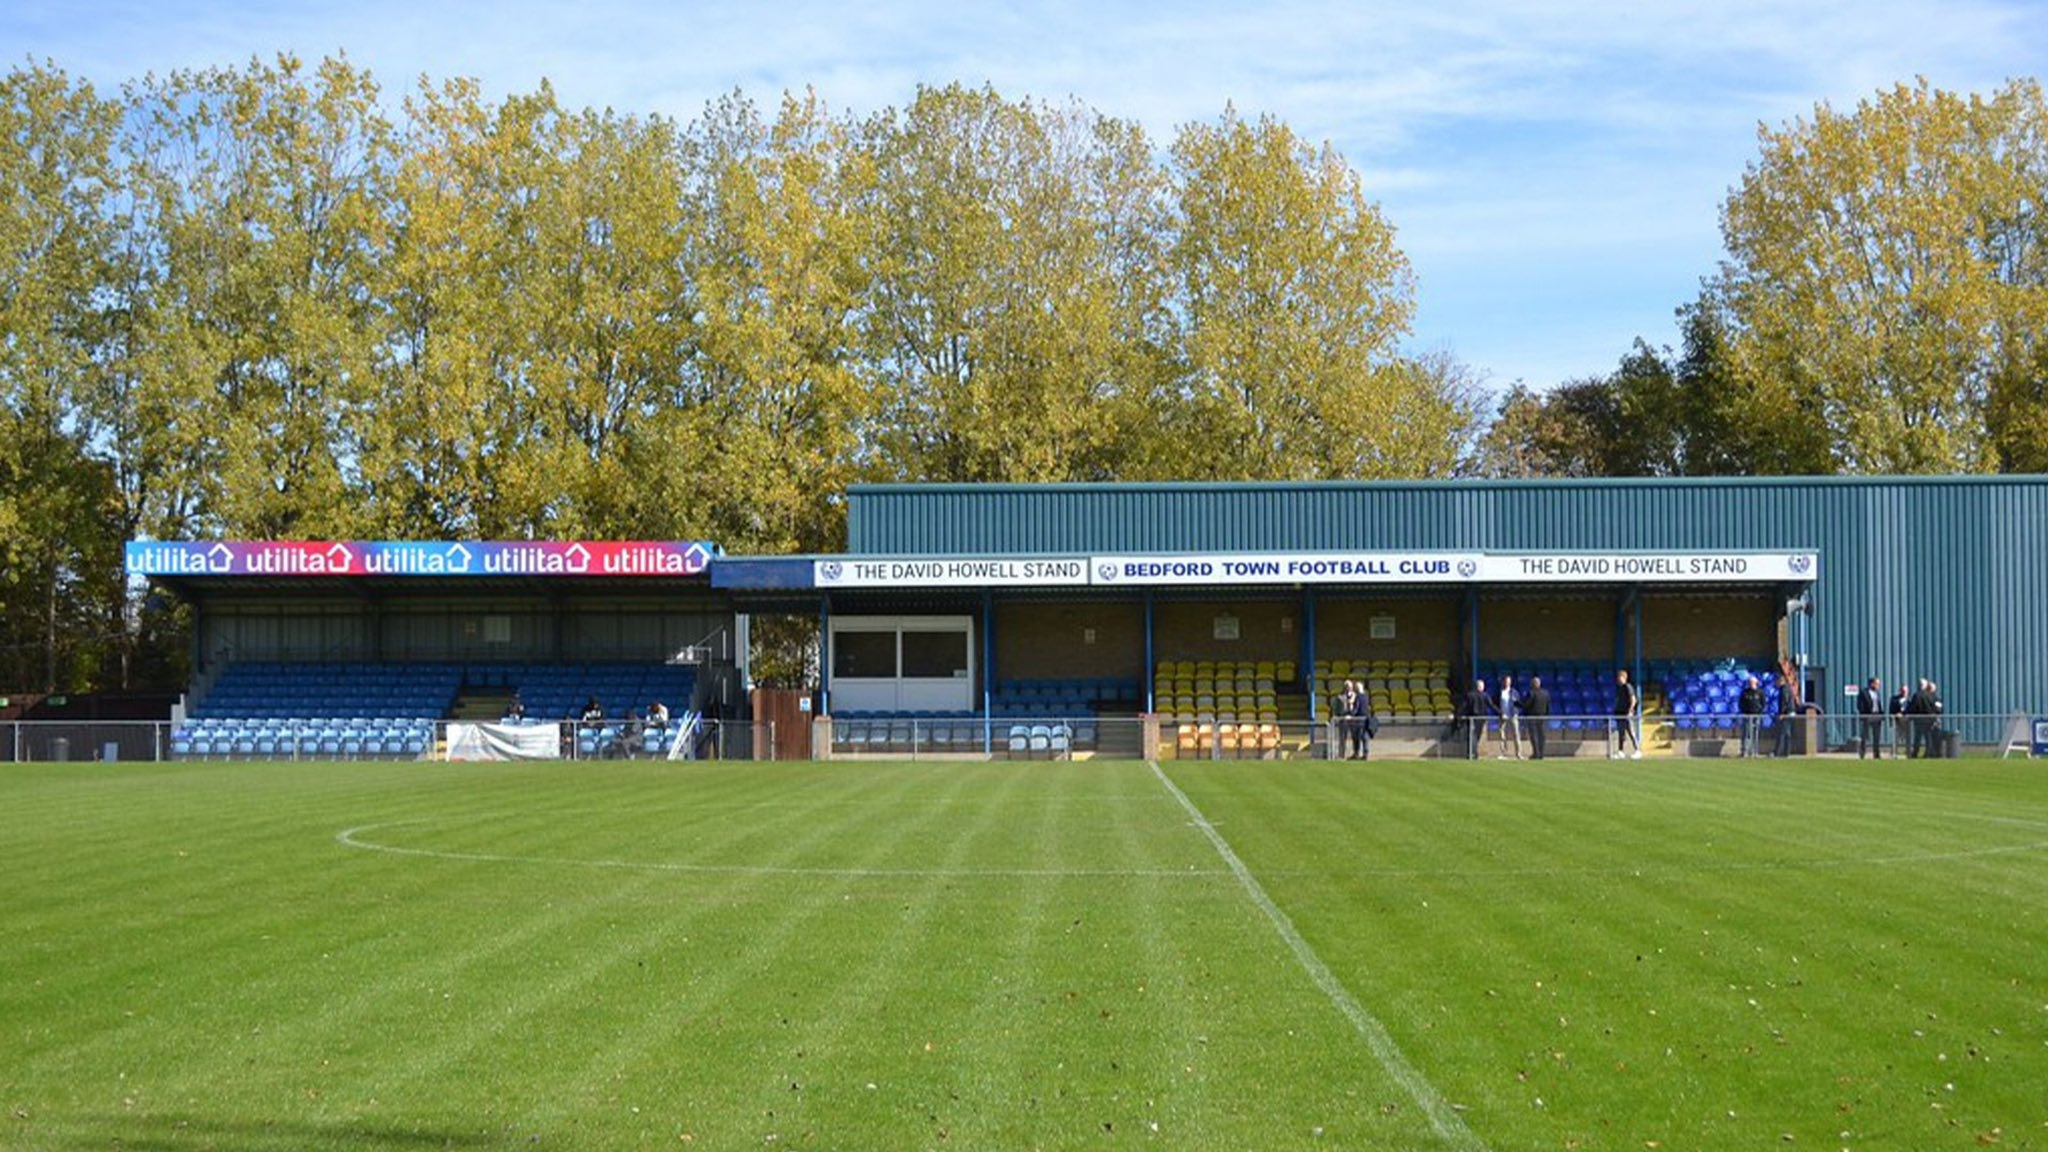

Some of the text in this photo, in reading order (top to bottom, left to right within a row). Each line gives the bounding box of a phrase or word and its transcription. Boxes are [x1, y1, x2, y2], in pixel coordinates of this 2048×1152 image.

[127, 548, 683, 573] utilita utilita utilita utilita utilita
[1124, 560, 1451, 577] BEDFORD TOWN FOOTBALL CLUB
[1520, 557, 1748, 574] THE DAVID HOWELL STAND
[854, 562, 1081, 580] THE DAVID HOWELL STAND
